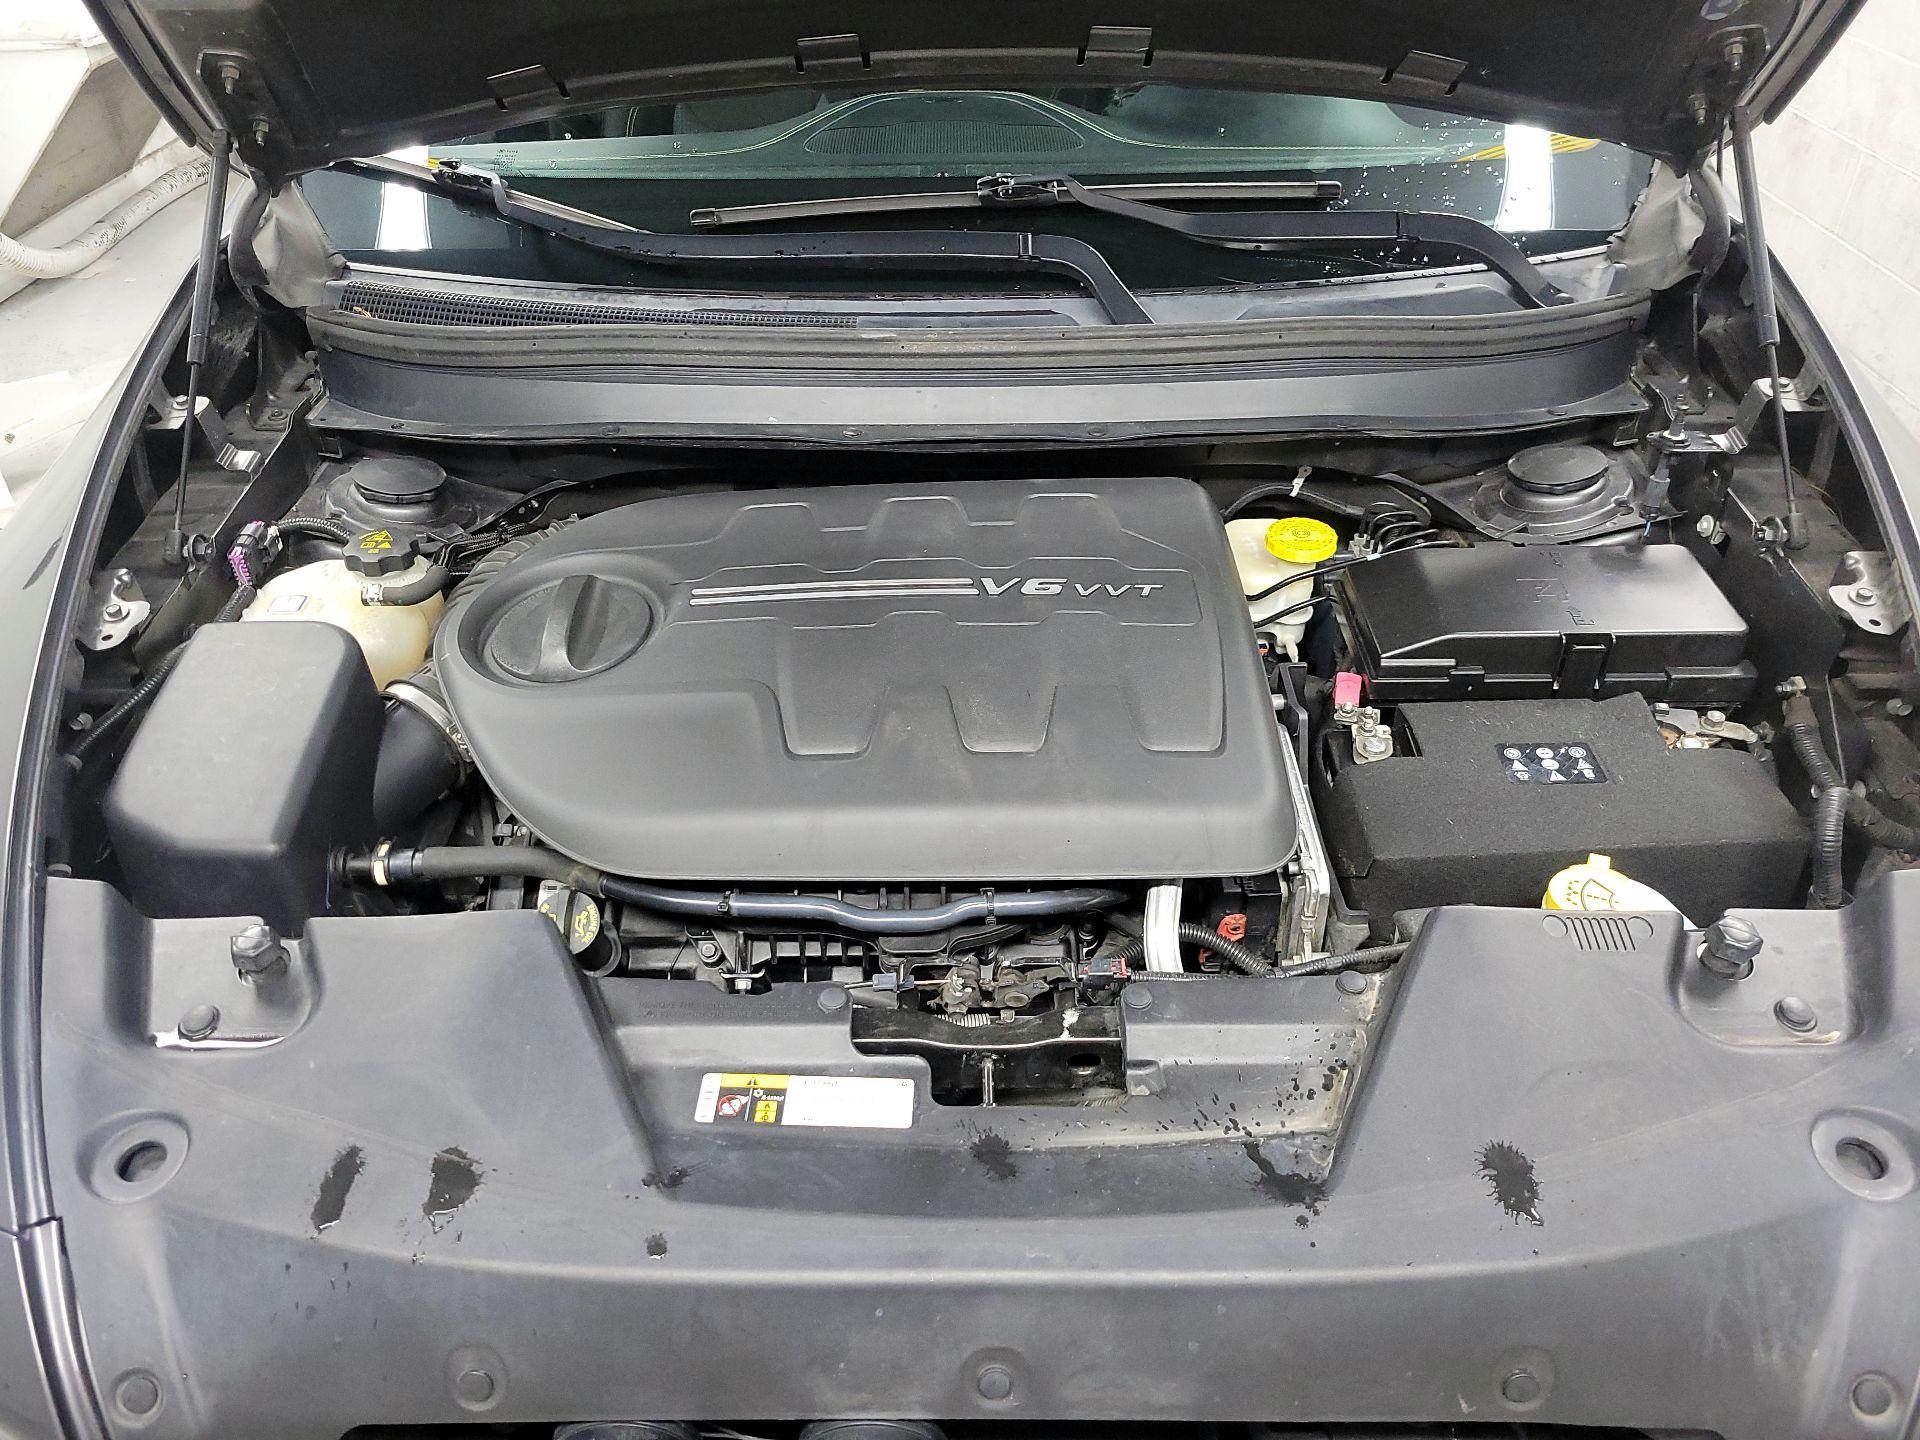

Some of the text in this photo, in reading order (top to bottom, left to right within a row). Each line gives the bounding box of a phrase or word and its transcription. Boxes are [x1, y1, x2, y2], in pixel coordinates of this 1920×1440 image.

[981, 577, 1164, 597] V6 VVT
[581, 903, 598, 944] ENGINE OIL
